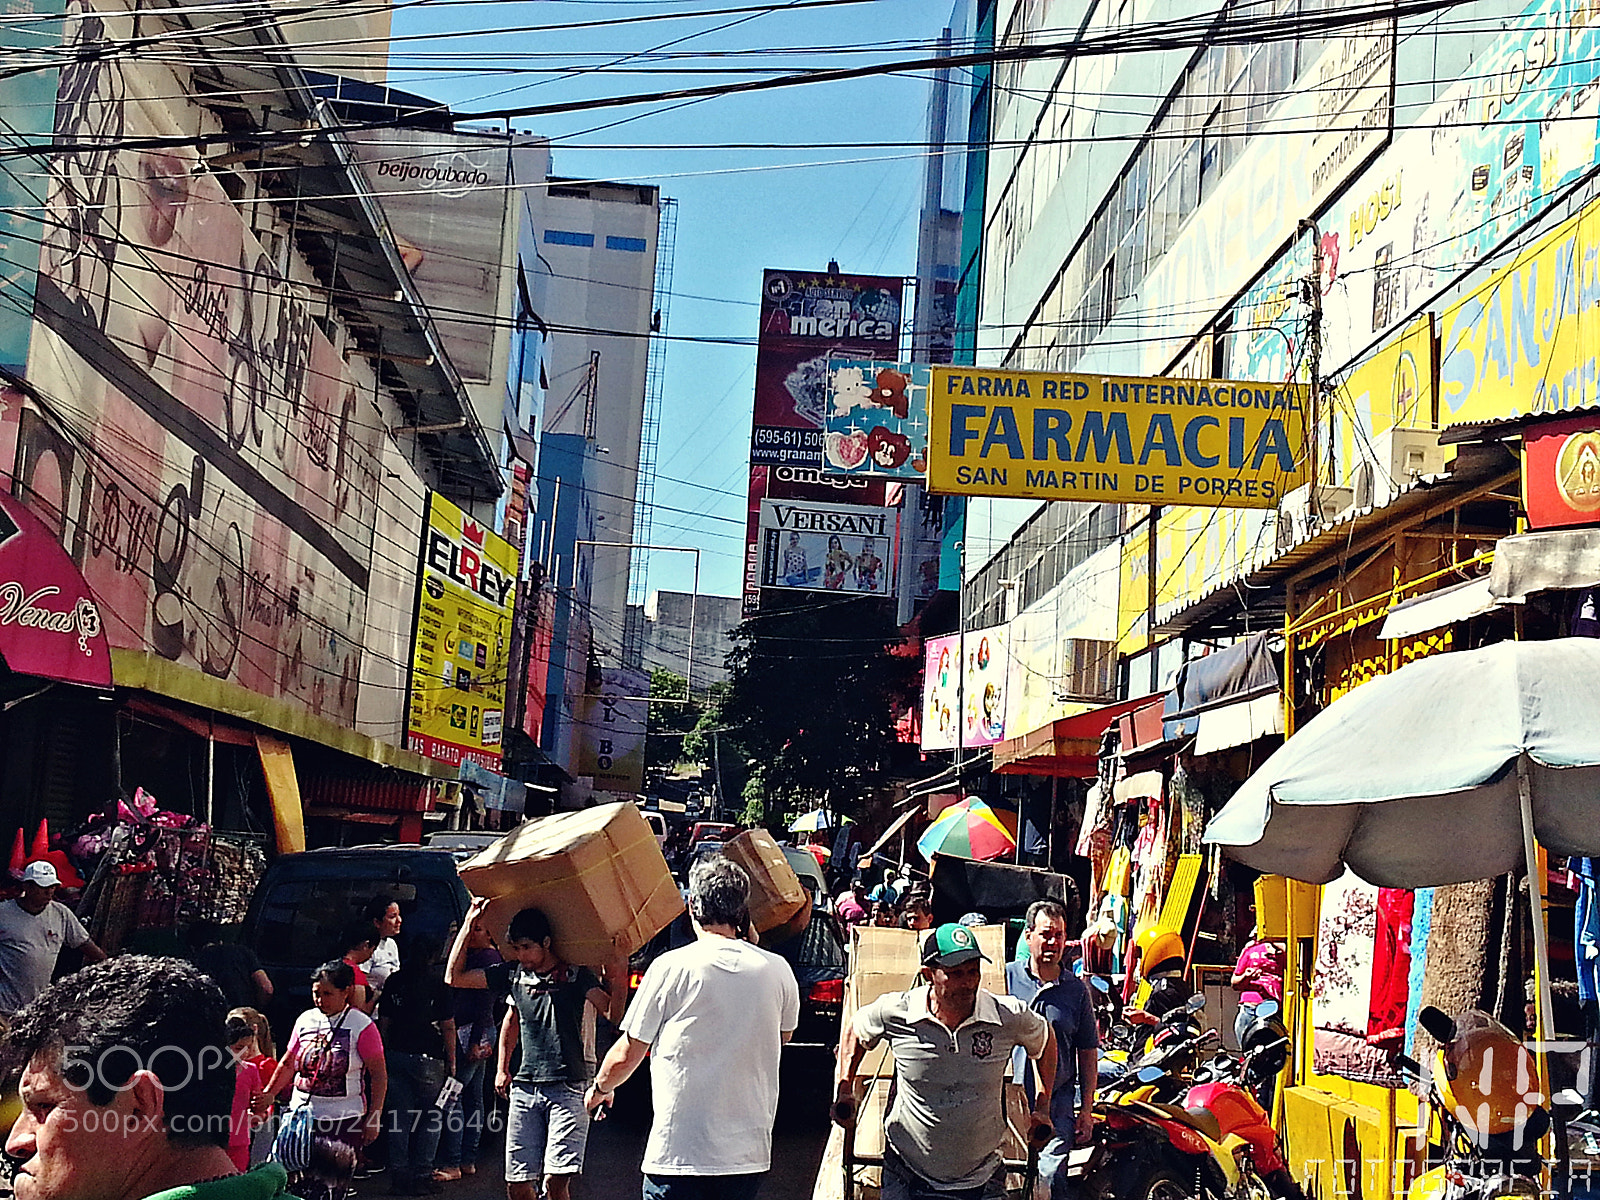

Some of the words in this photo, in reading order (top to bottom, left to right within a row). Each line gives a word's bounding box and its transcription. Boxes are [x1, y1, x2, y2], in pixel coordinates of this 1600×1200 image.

[377, 161, 488, 185] beijoroubado
[1348, 166, 1403, 252] HOSI
[1442, 259, 1541, 414] SAN
[947, 376, 1031, 399] FARMA
[1042, 380, 1090, 400] RED
[1102, 381, 1302, 411] INTERNACIONAL
[754, 429, 802, 446] (595-61)
[949, 403, 1297, 473] FARMACIA
[956, 466, 1008, 486] SAN
[1026, 469, 1119, 491] MARTIN
[1135, 474, 1165, 493] DE
[1179, 476, 1276, 498] PORRES
[0, 581, 75, 632] Venas
[431, 742, 460, 764] BARATO
